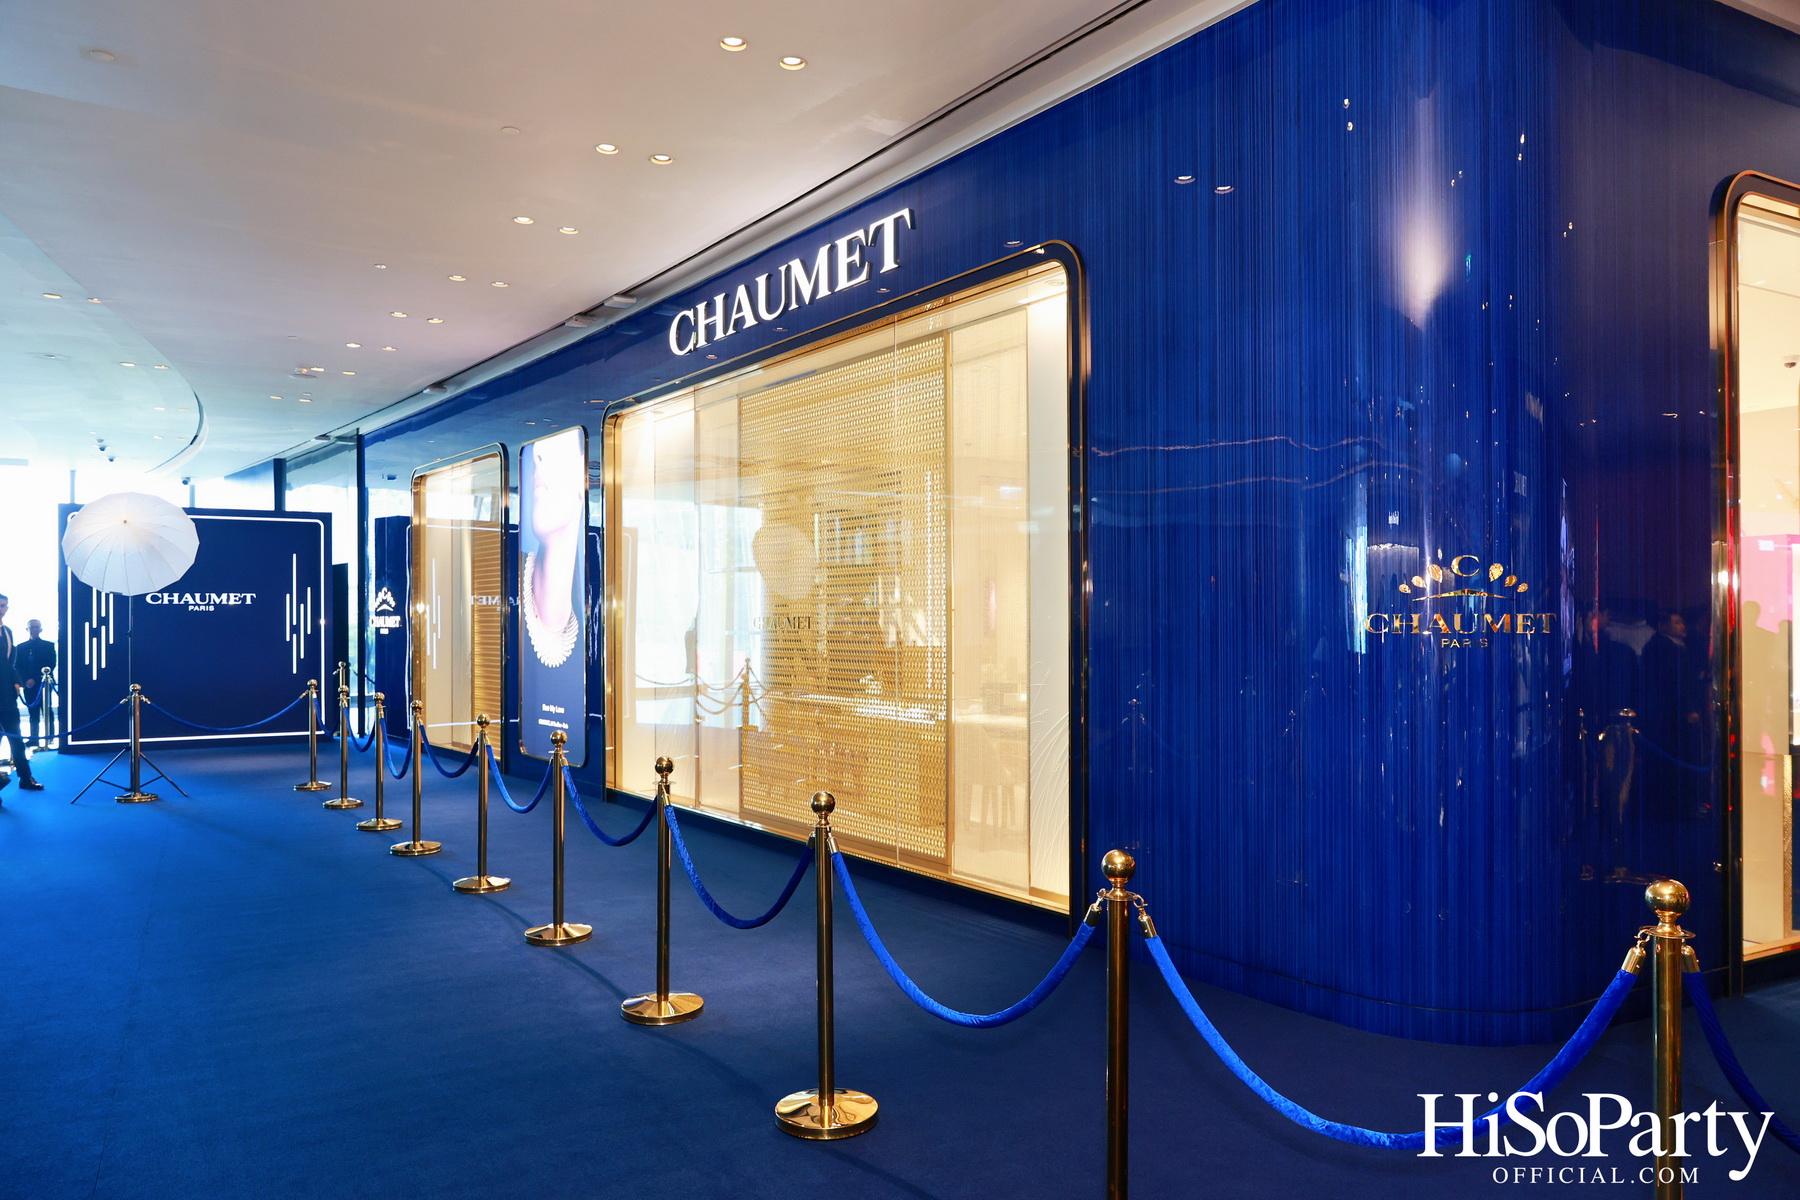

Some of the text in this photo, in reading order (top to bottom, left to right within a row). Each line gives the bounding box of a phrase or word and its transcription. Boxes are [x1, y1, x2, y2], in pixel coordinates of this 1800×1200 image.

[668, 207, 914, 356] CHAUMET
[1450, 554, 1481, 577] C
[145, 592, 257, 605] CHAUMET
[1364, 612, 1558, 635] CHAUMET
[1440, 638, 1489, 649] PARIS
